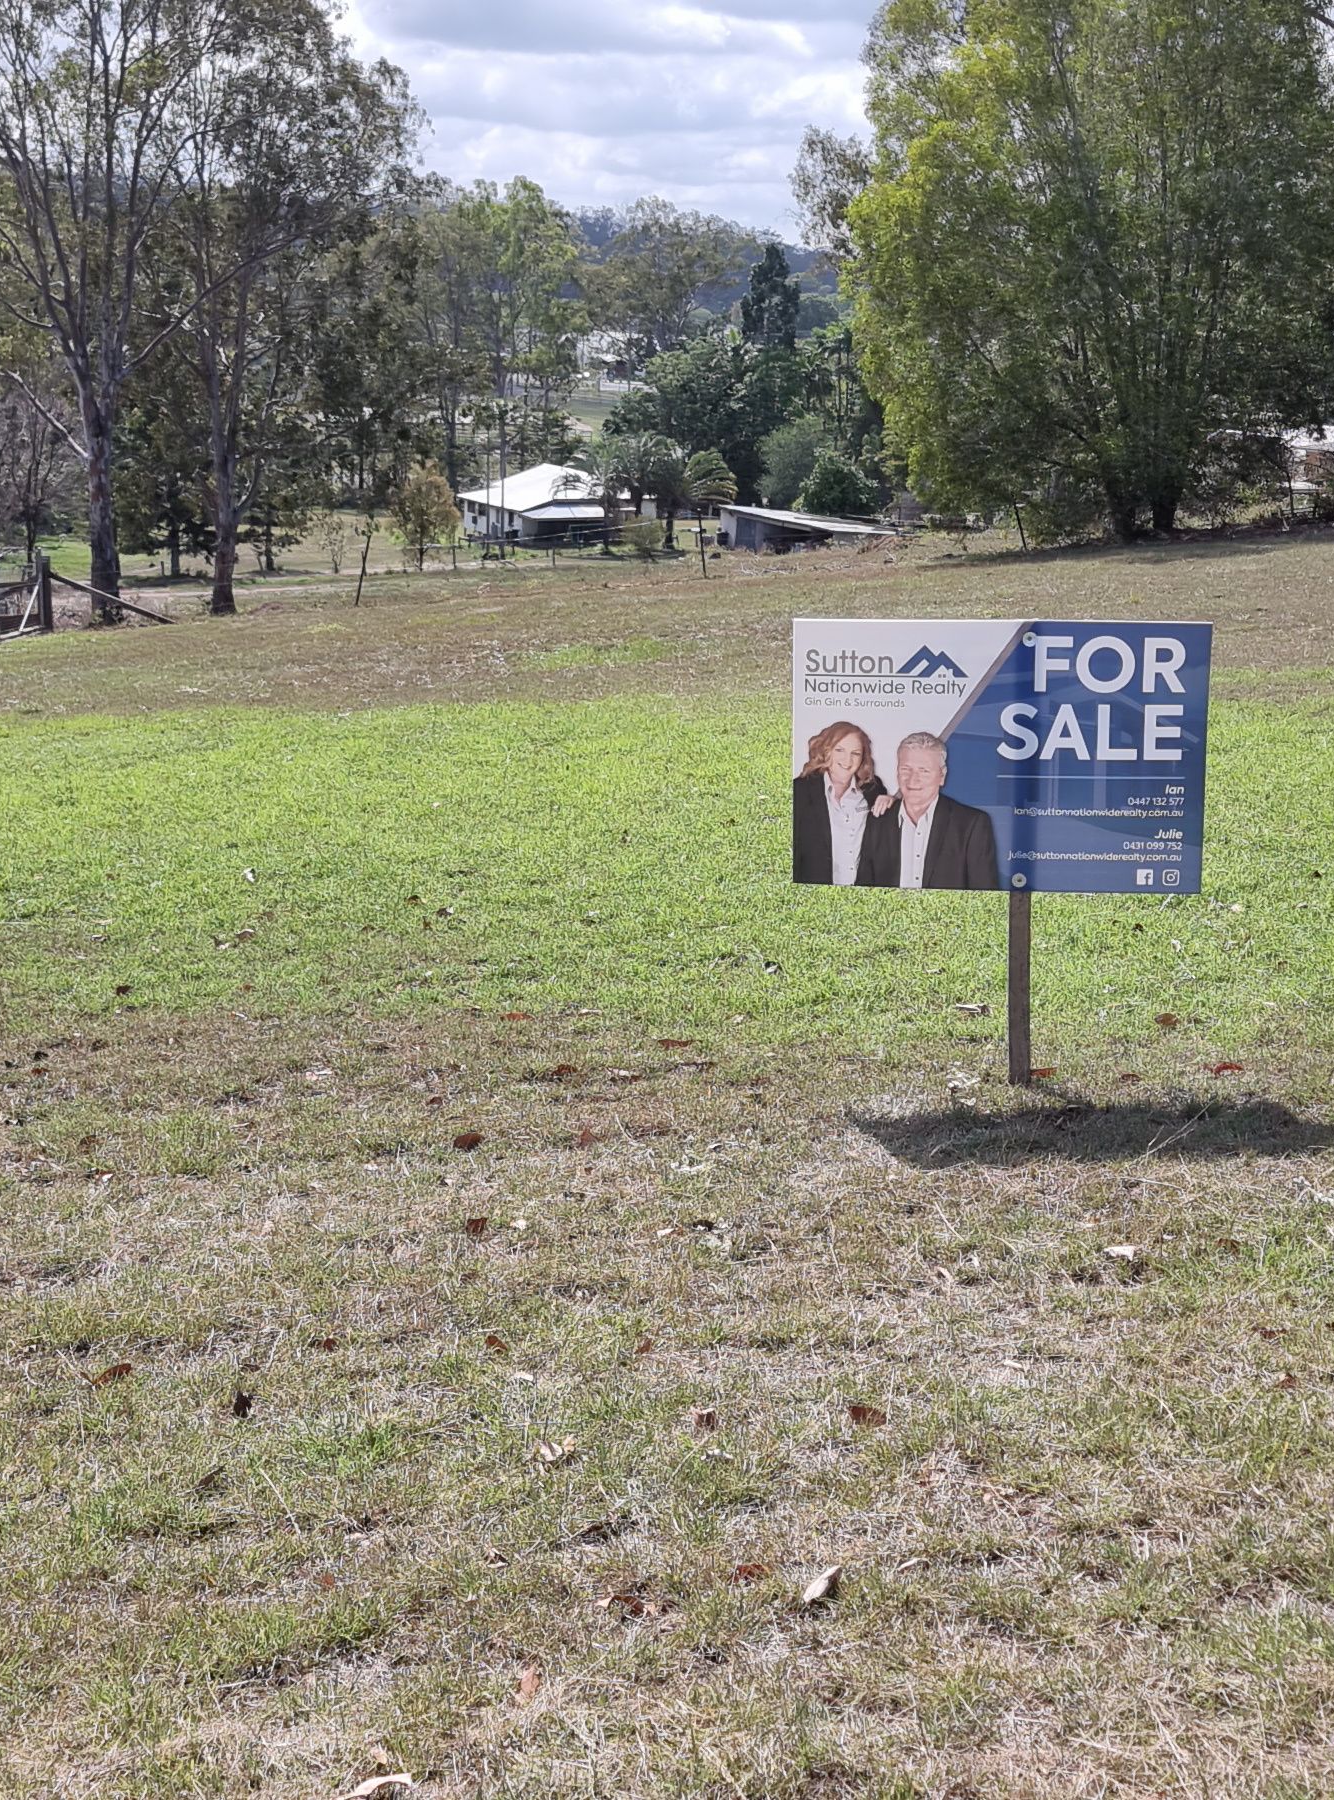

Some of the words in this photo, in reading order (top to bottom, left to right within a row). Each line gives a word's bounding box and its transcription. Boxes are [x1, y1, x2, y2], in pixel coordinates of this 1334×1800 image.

[805, 648, 894, 674] Sutton
[1034, 635, 1186, 693] FOR
[804, 678, 906, 695] Nationwide
[911, 679, 967, 698] Realty
[804, 697, 822, 706] Gin
[824, 697, 842, 707] Gin
[844, 698, 852, 707] &
[854, 698, 905, 708] Surrounds
[996, 702, 1184, 761] SALE
[1165, 784, 1185, 795] Ian
[1127, 797, 1151, 806] 0447
[1153, 797, 1167, 806] 132
[1170, 797, 1185, 806] 577
[1154, 828, 1183, 840] Julie
[1123, 841, 1145, 851] 0431
[1146, 841, 1165, 851] 099
[1166, 842, 1183, 851] 752
